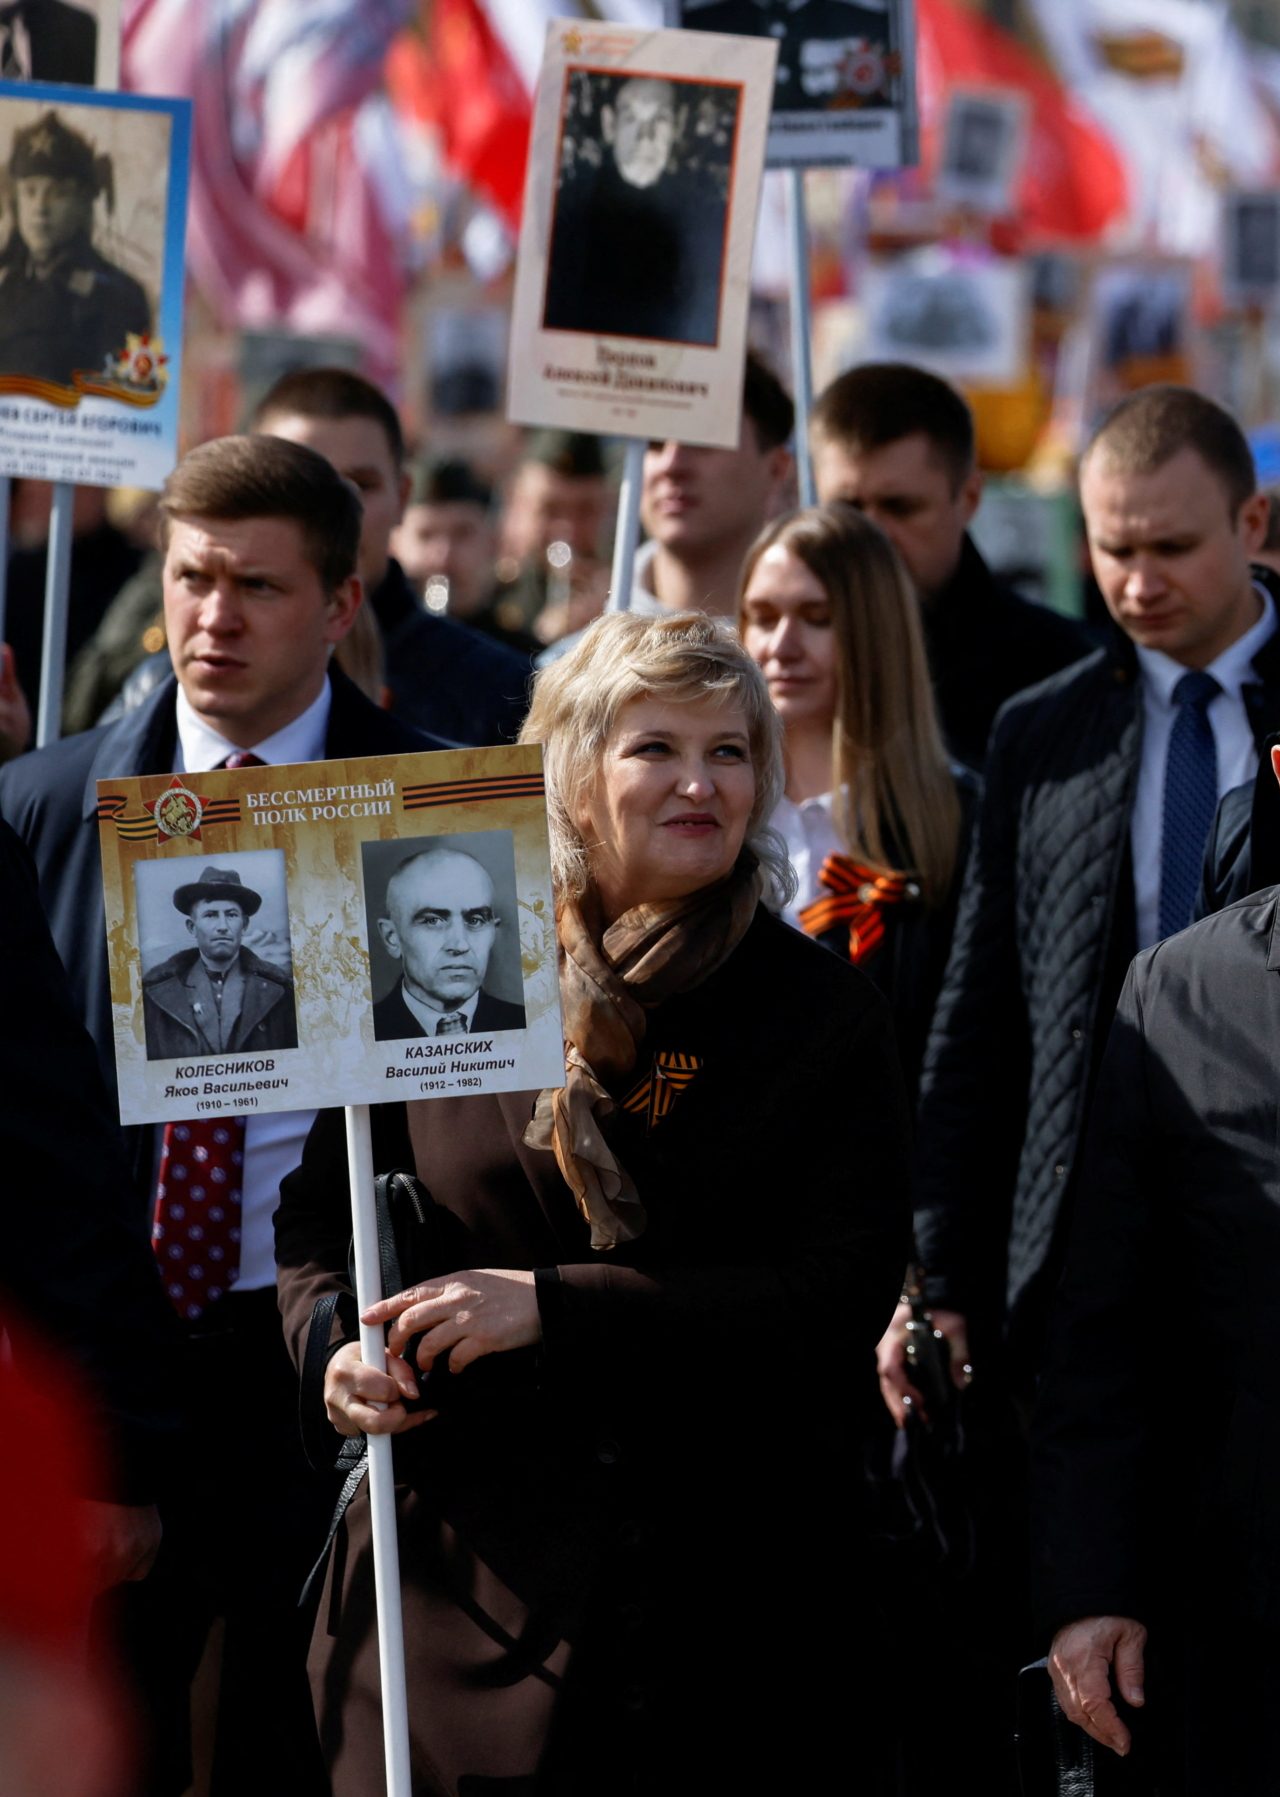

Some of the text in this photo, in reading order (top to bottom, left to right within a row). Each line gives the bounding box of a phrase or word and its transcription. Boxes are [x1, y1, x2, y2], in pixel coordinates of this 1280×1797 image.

[246, 779, 396, 808] БЕССМЕРТНЫЙ
[252, 801, 392, 826] ПОЛК РОССИИ
[405, 1040, 494, 1059] КАЗАНСКИХ
[175, 1059, 275, 1079] КОЛЕСНИКОВ
[386, 1058, 515, 1078] Василий Никитич
[164, 1078, 289, 1098] Яков Васильевич
[420, 1080, 446, 1092] (1912
[456, 1077, 482, 1088] 1982)
[196, 1101, 222, 1112] (1910
[232, 1097, 258, 1107] 1961)
